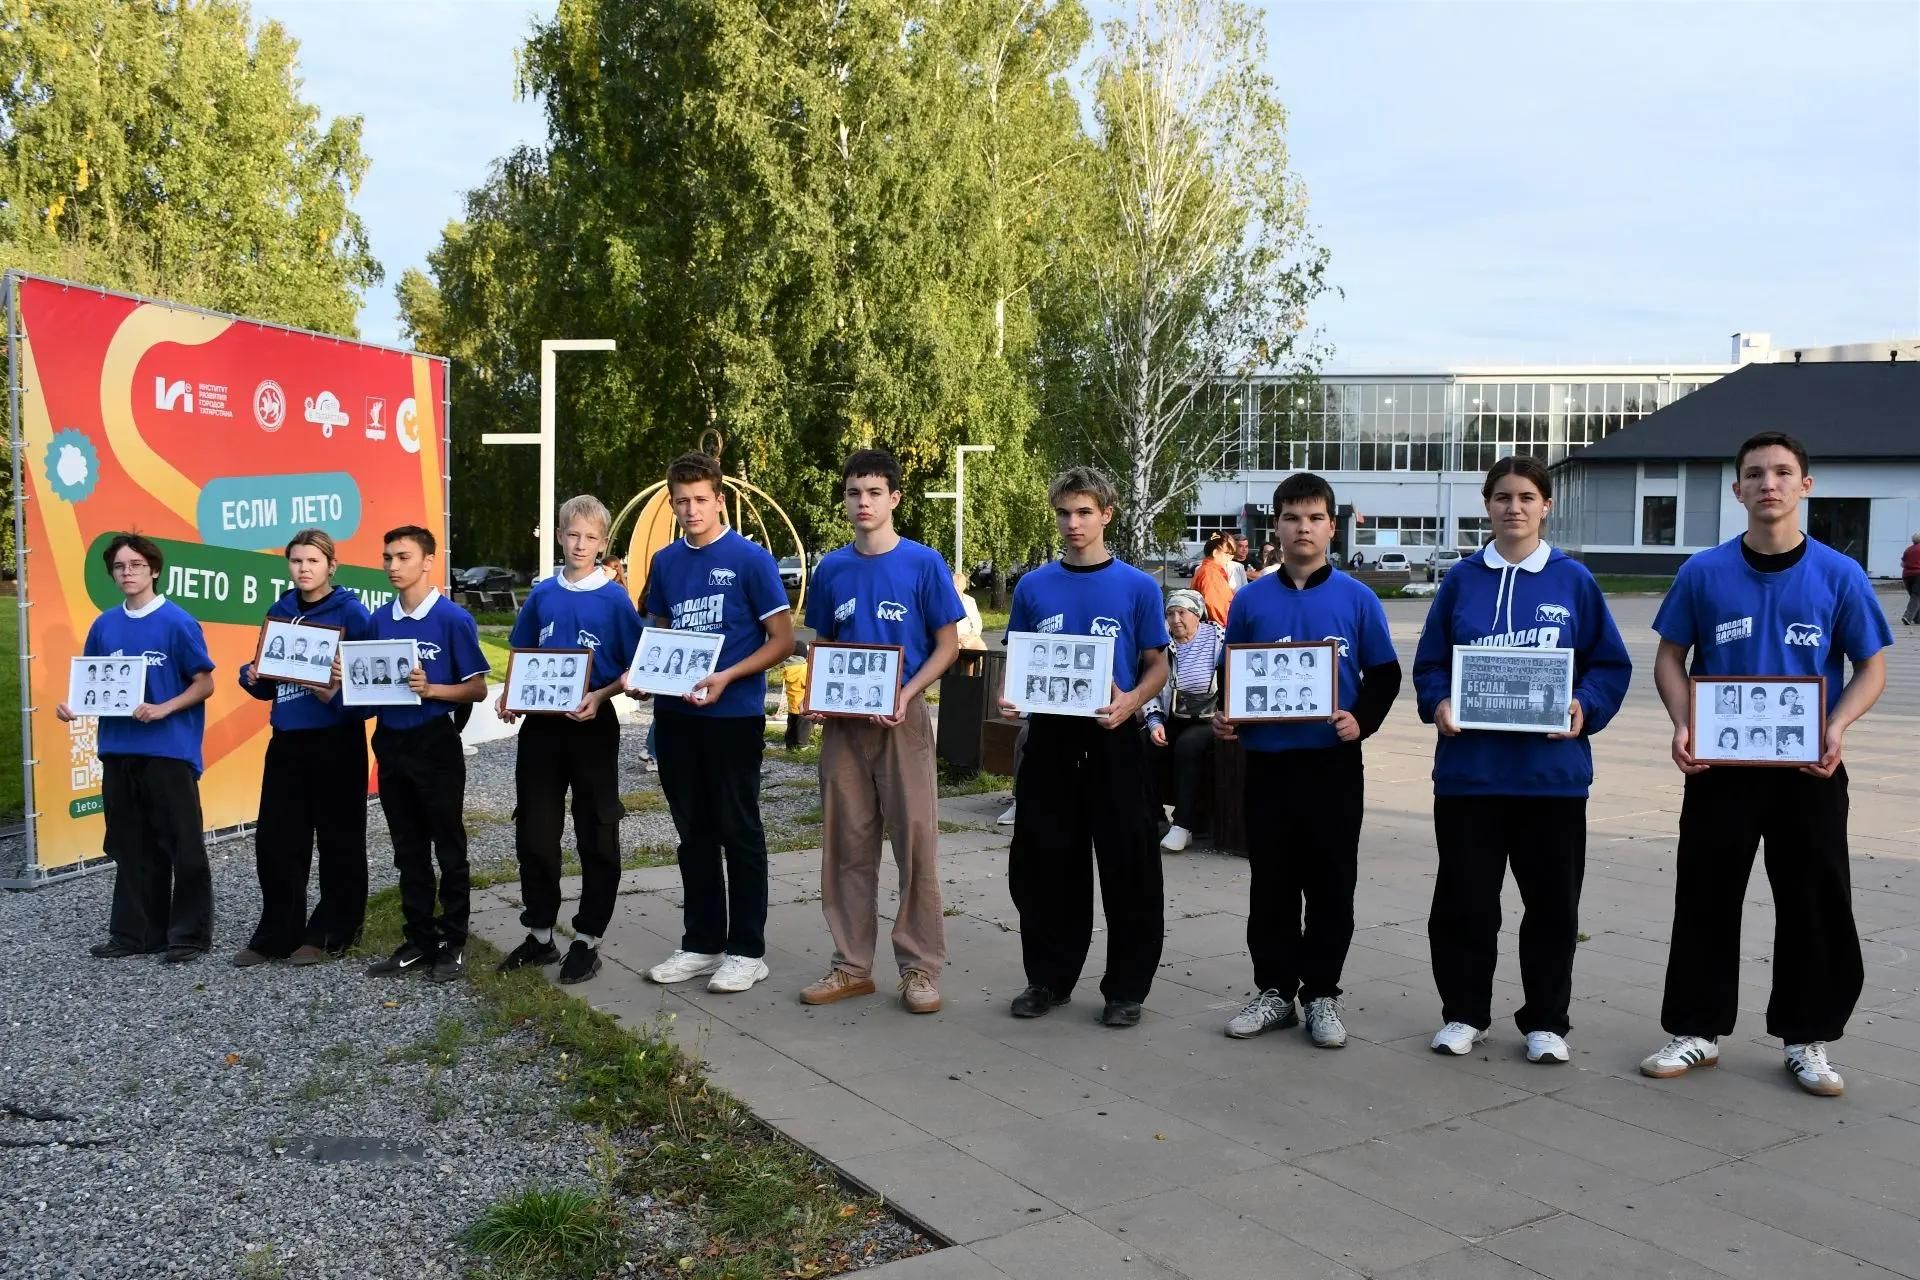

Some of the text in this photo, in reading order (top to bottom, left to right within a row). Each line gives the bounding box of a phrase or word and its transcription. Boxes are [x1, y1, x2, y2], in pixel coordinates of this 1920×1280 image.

[198, 383, 228, 393] ИНСТИТУТ
[199, 399, 224, 409] ГОРОДОВ
[221, 493, 342, 530] ЕСЛИ ЛЕТО
[166, 565, 229, 601] ЛЕТО
[243, 575, 258, 604] В
[670, 593, 724, 618] МООДАЯ
[1466, 696, 1526, 710] МЫ ПОМНИМ
[76, 799, 104, 813] leto.
